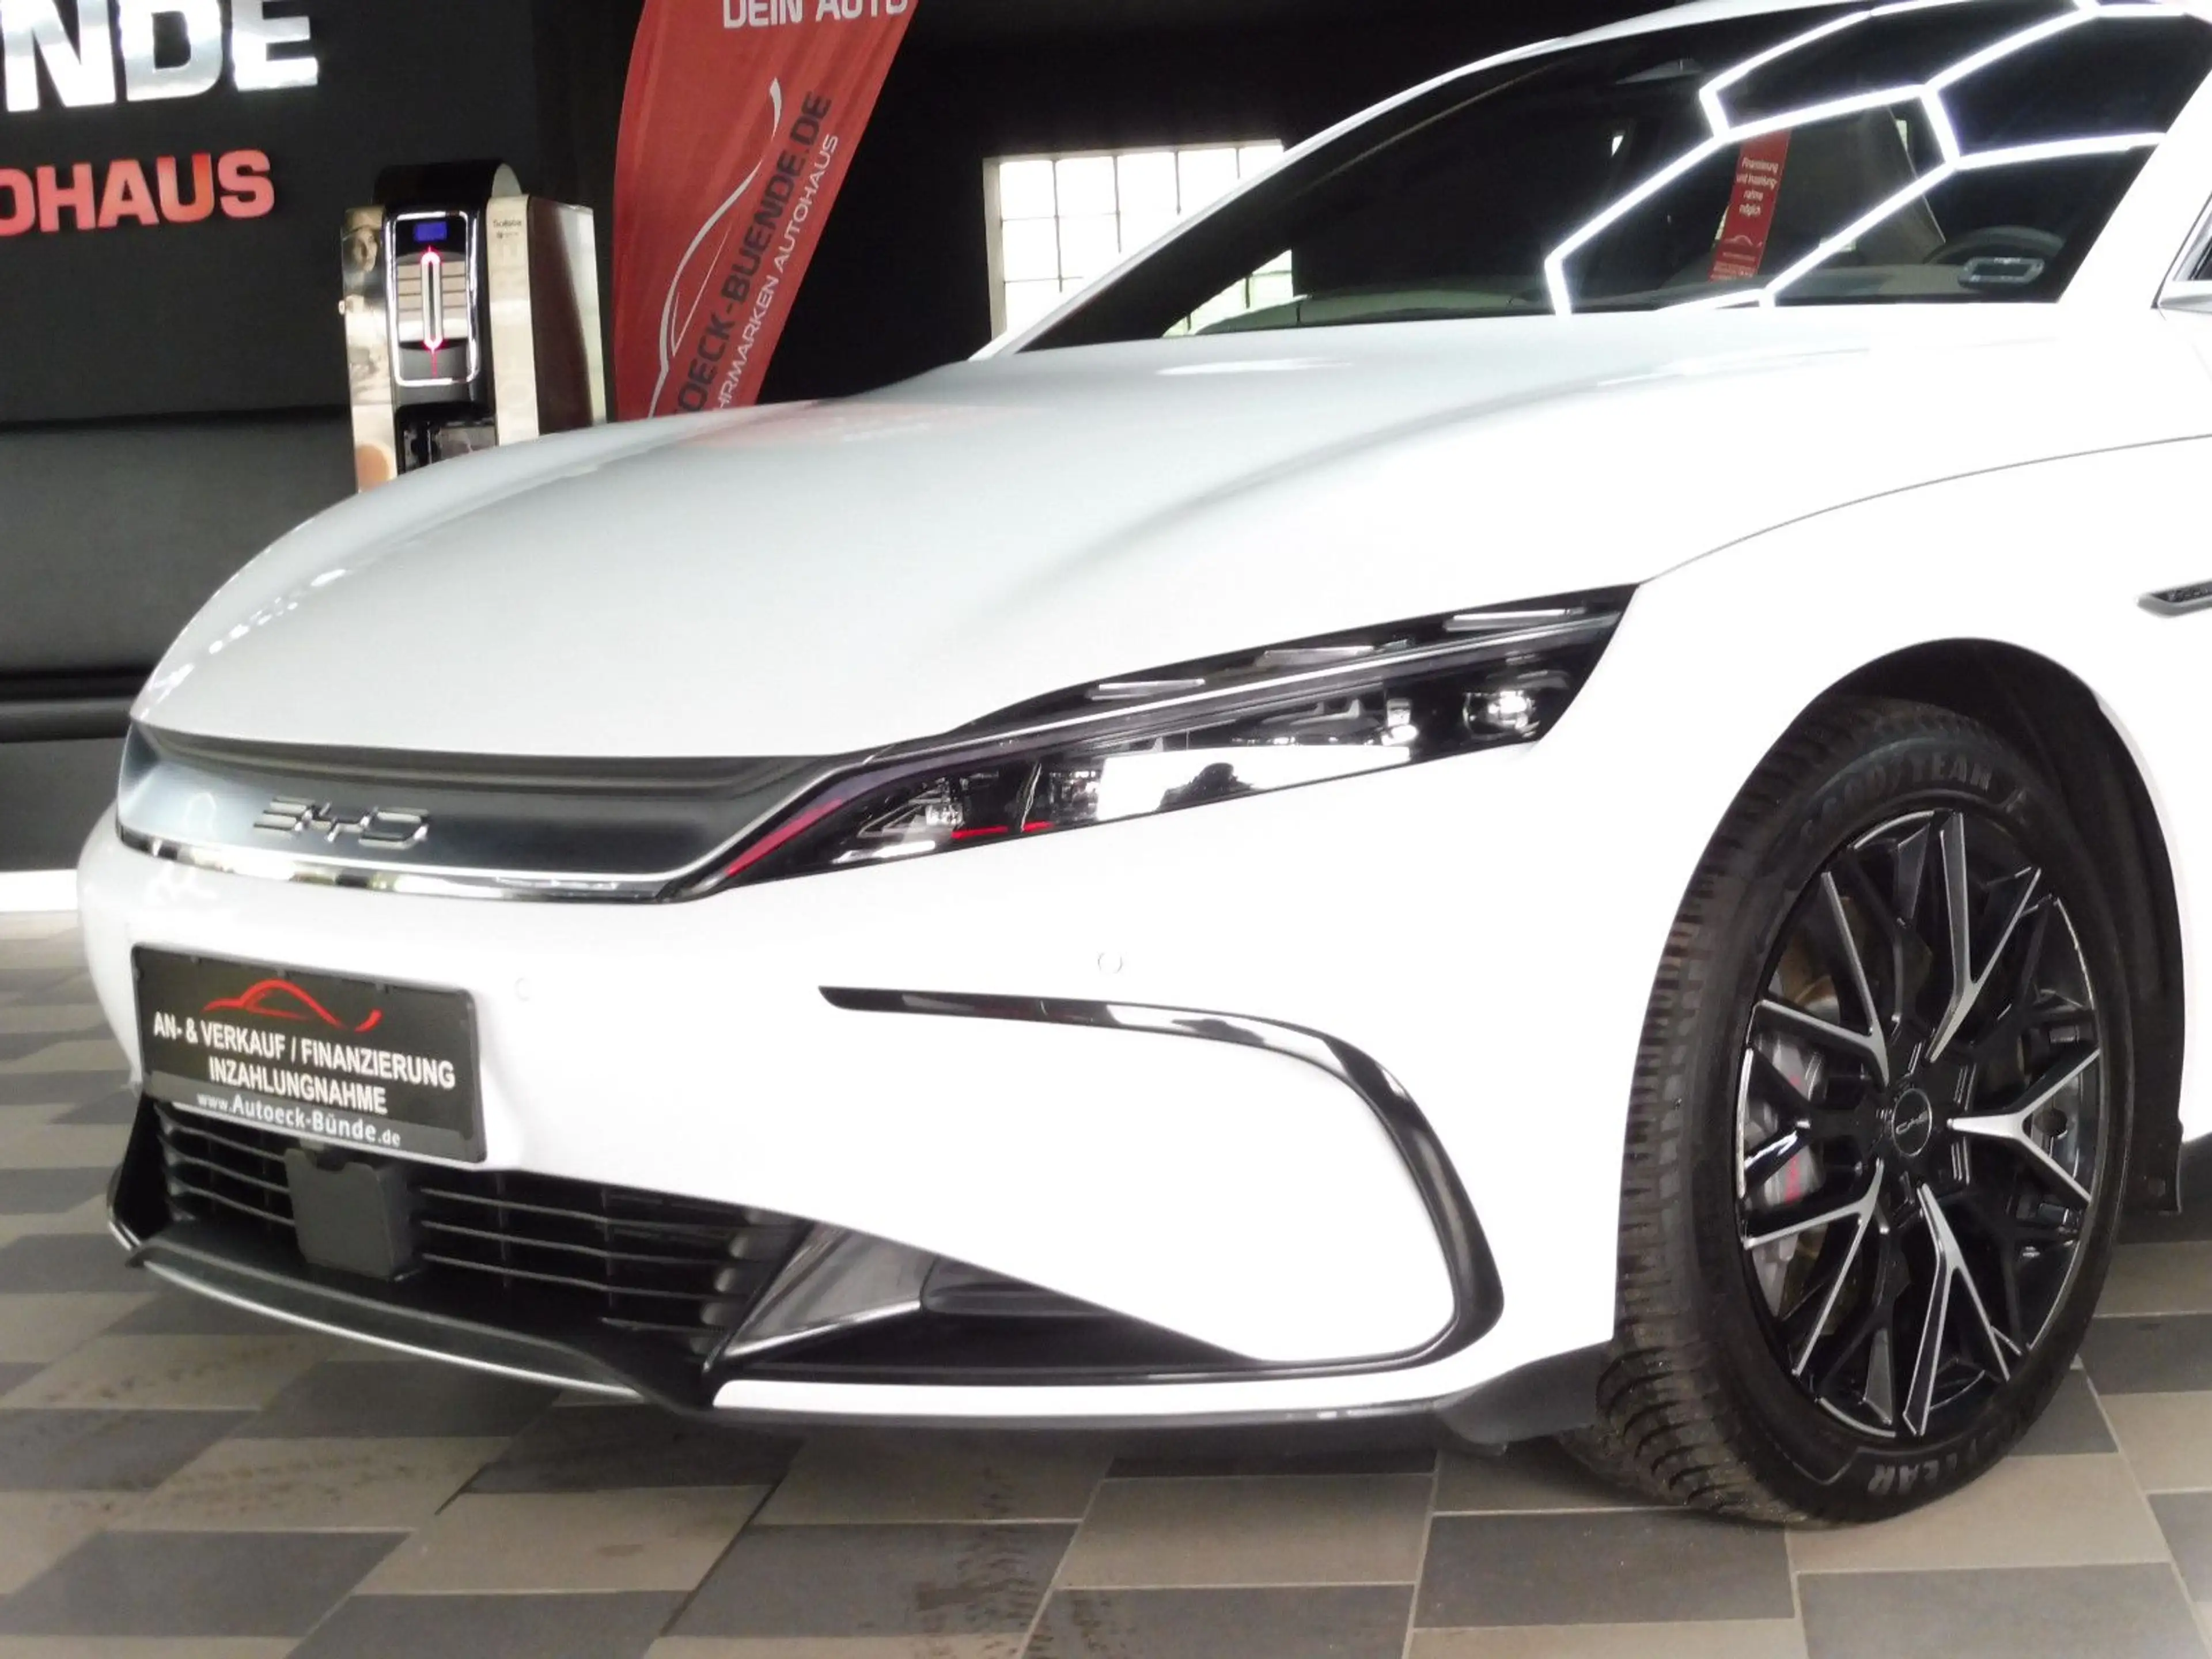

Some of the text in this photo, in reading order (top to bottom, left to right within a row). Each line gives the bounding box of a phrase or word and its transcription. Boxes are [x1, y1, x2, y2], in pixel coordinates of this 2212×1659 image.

[724, 0, 803, 28] DEIN
[0, 0, 319, 112] NDE
[0, 149, 275, 237] OHAUS
[774, 133, 838, 274] AUTOHAUS
[677, 90, 831, 412] OECK-BUENDE.DE
[253, 796, 430, 850] BYD
[154, 1012, 456, 1089] AN- & VERKAUF / FINANZIERUNG
[209, 1055, 388, 1115] INZAHLUNGNAHME
[196, 1093, 402, 1147] www.Autoeck-Bünde.de
